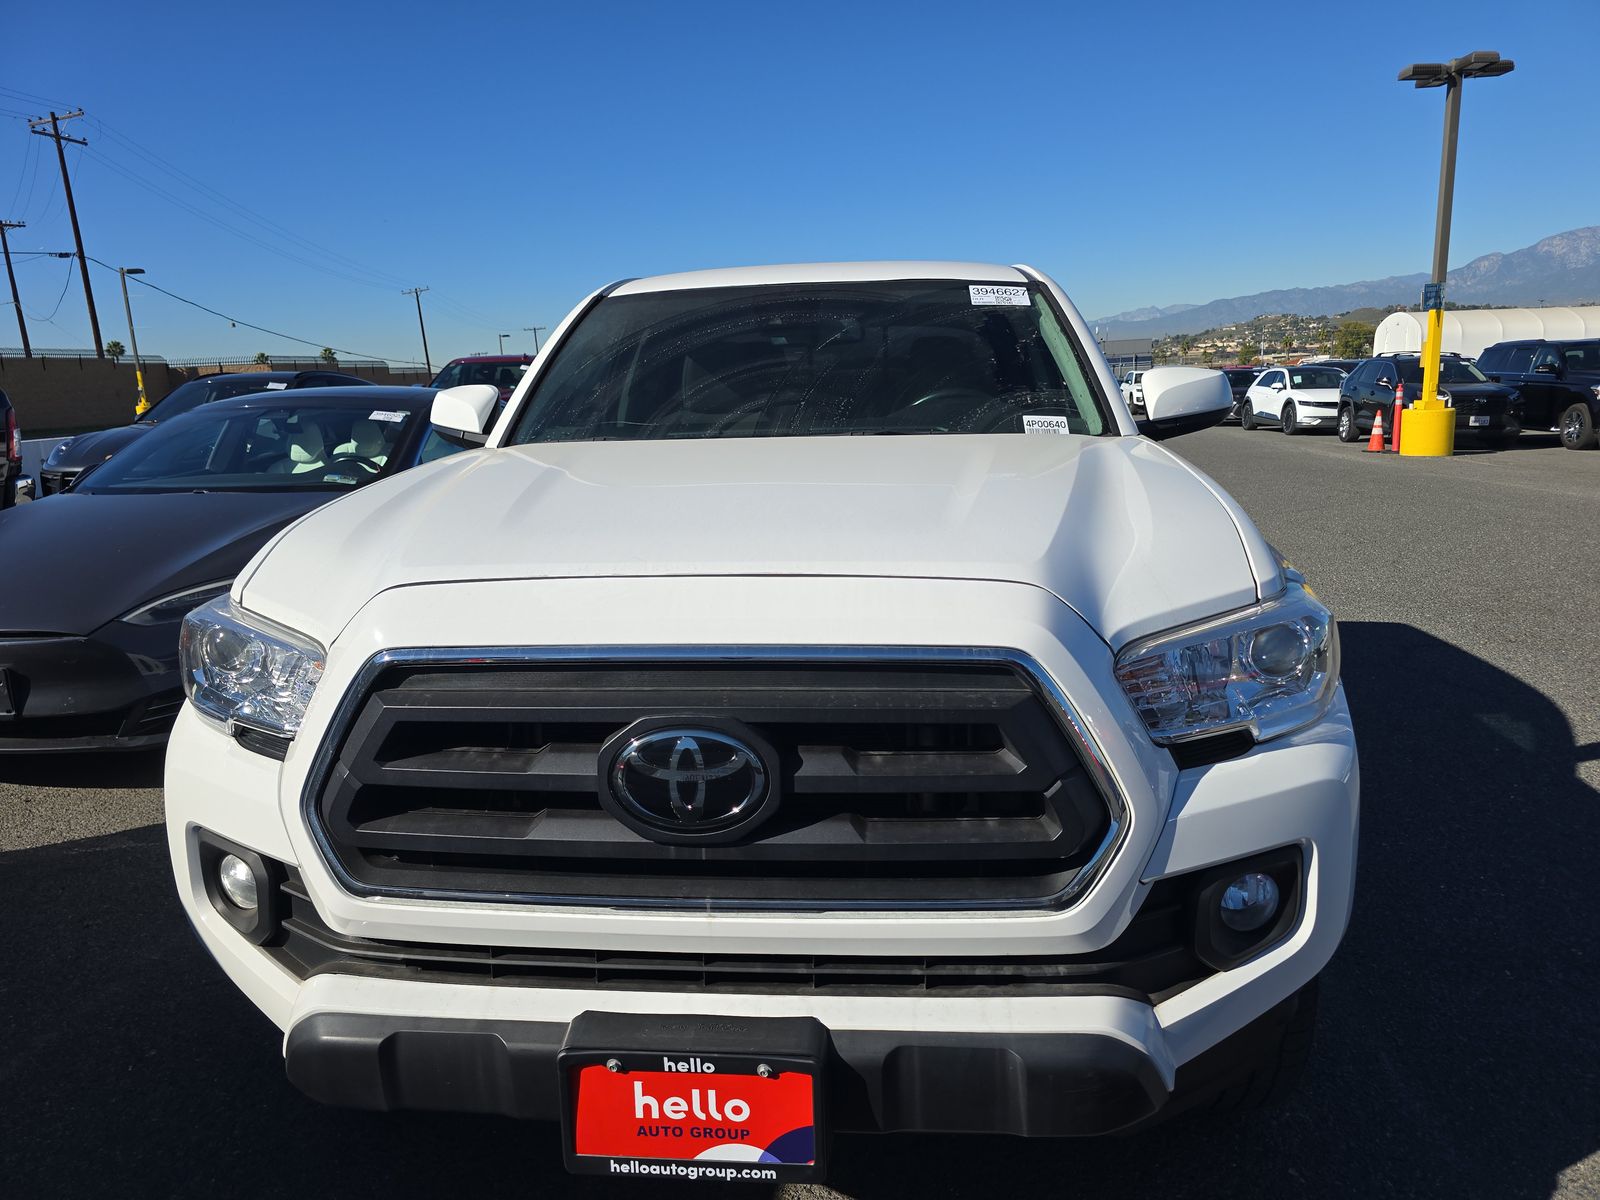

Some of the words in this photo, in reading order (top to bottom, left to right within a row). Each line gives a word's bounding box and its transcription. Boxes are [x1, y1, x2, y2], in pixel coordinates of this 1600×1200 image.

[972, 287, 1027, 296] 3946627
[1026, 419, 1066, 429] 4P00640
[663, 1057, 715, 1073] hello
[633, 1081, 751, 1122] hello
[637, 1126, 683, 1138] AUTO
[690, 1127, 750, 1140] GROUP
[610, 1160, 777, 1181] helloautogroup.com
